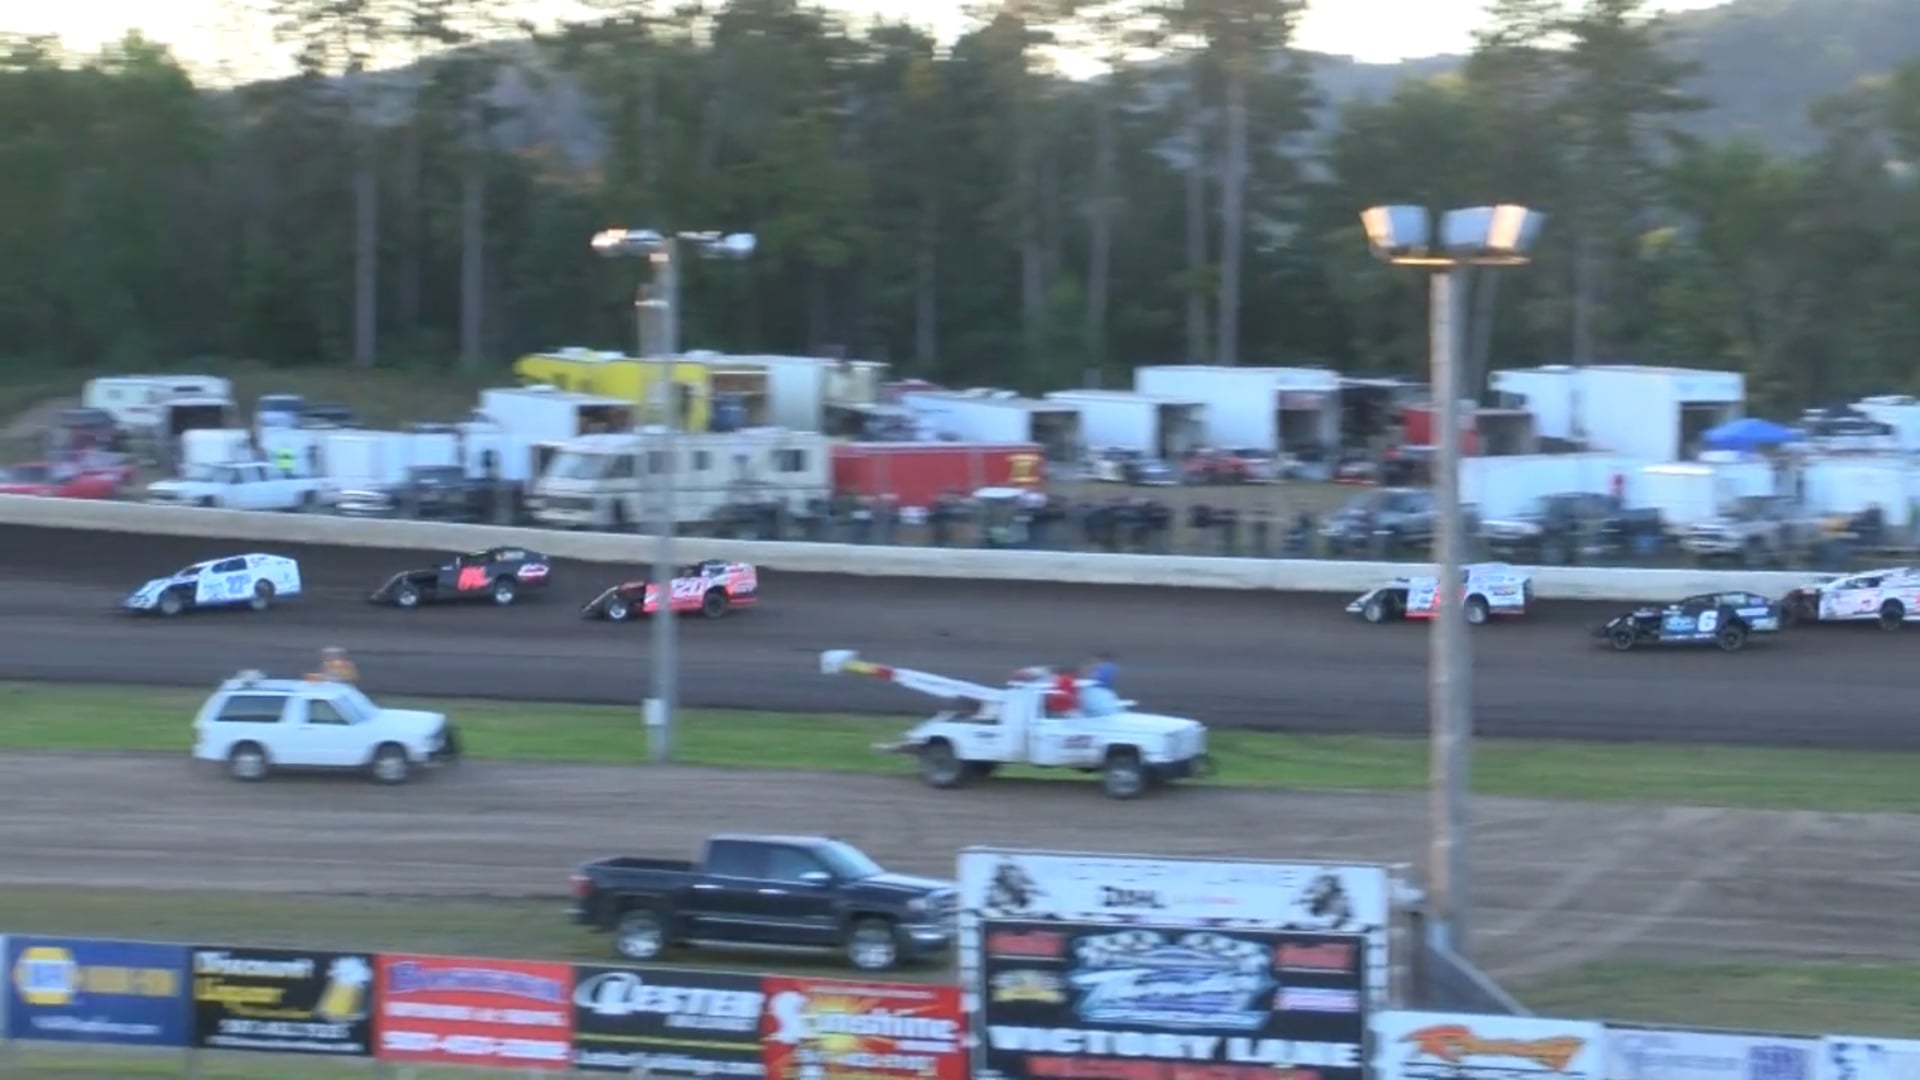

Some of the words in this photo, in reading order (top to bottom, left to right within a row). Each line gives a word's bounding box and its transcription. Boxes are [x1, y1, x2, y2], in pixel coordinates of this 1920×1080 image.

[1698, 610, 1718, 632] 6
[987, 1026, 1217, 1060] VICTORY
[1225, 1036, 1363, 1067] LANE
